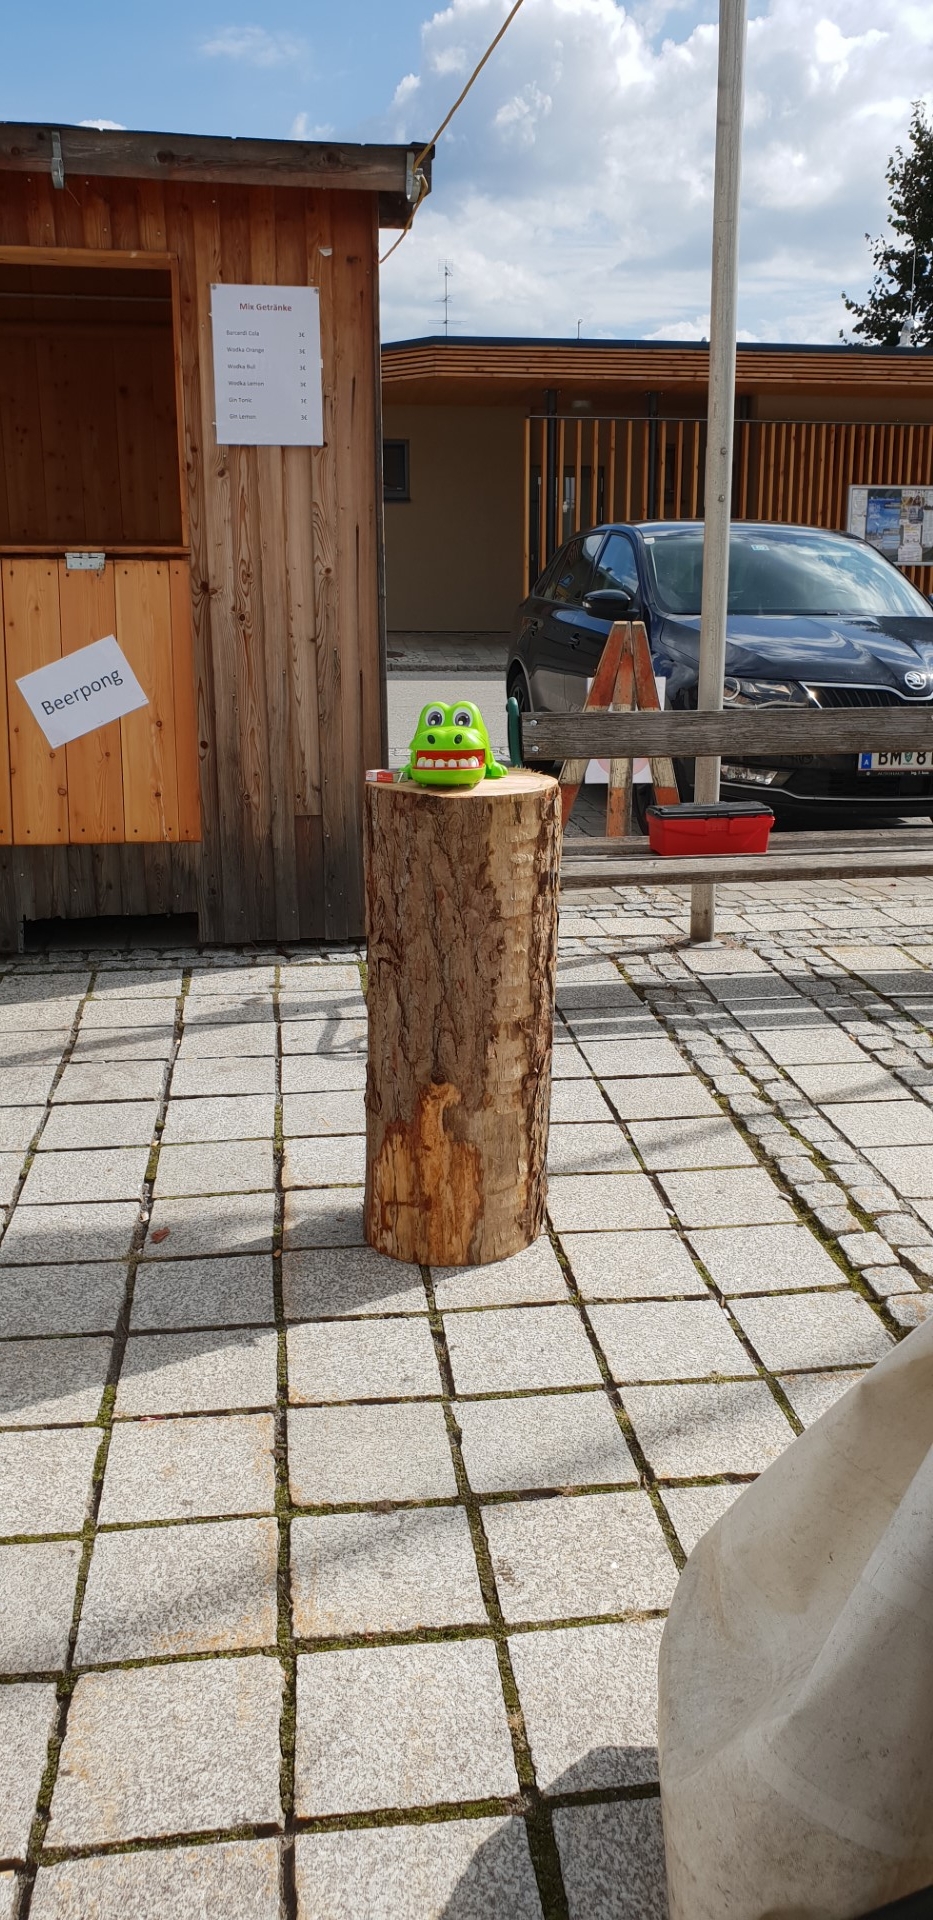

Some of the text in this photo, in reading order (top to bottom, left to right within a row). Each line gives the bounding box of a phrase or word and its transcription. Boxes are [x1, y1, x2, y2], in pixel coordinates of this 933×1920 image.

[239, 302, 293, 312] Mix Getränke
[41, 670, 123, 715] Beerpong
